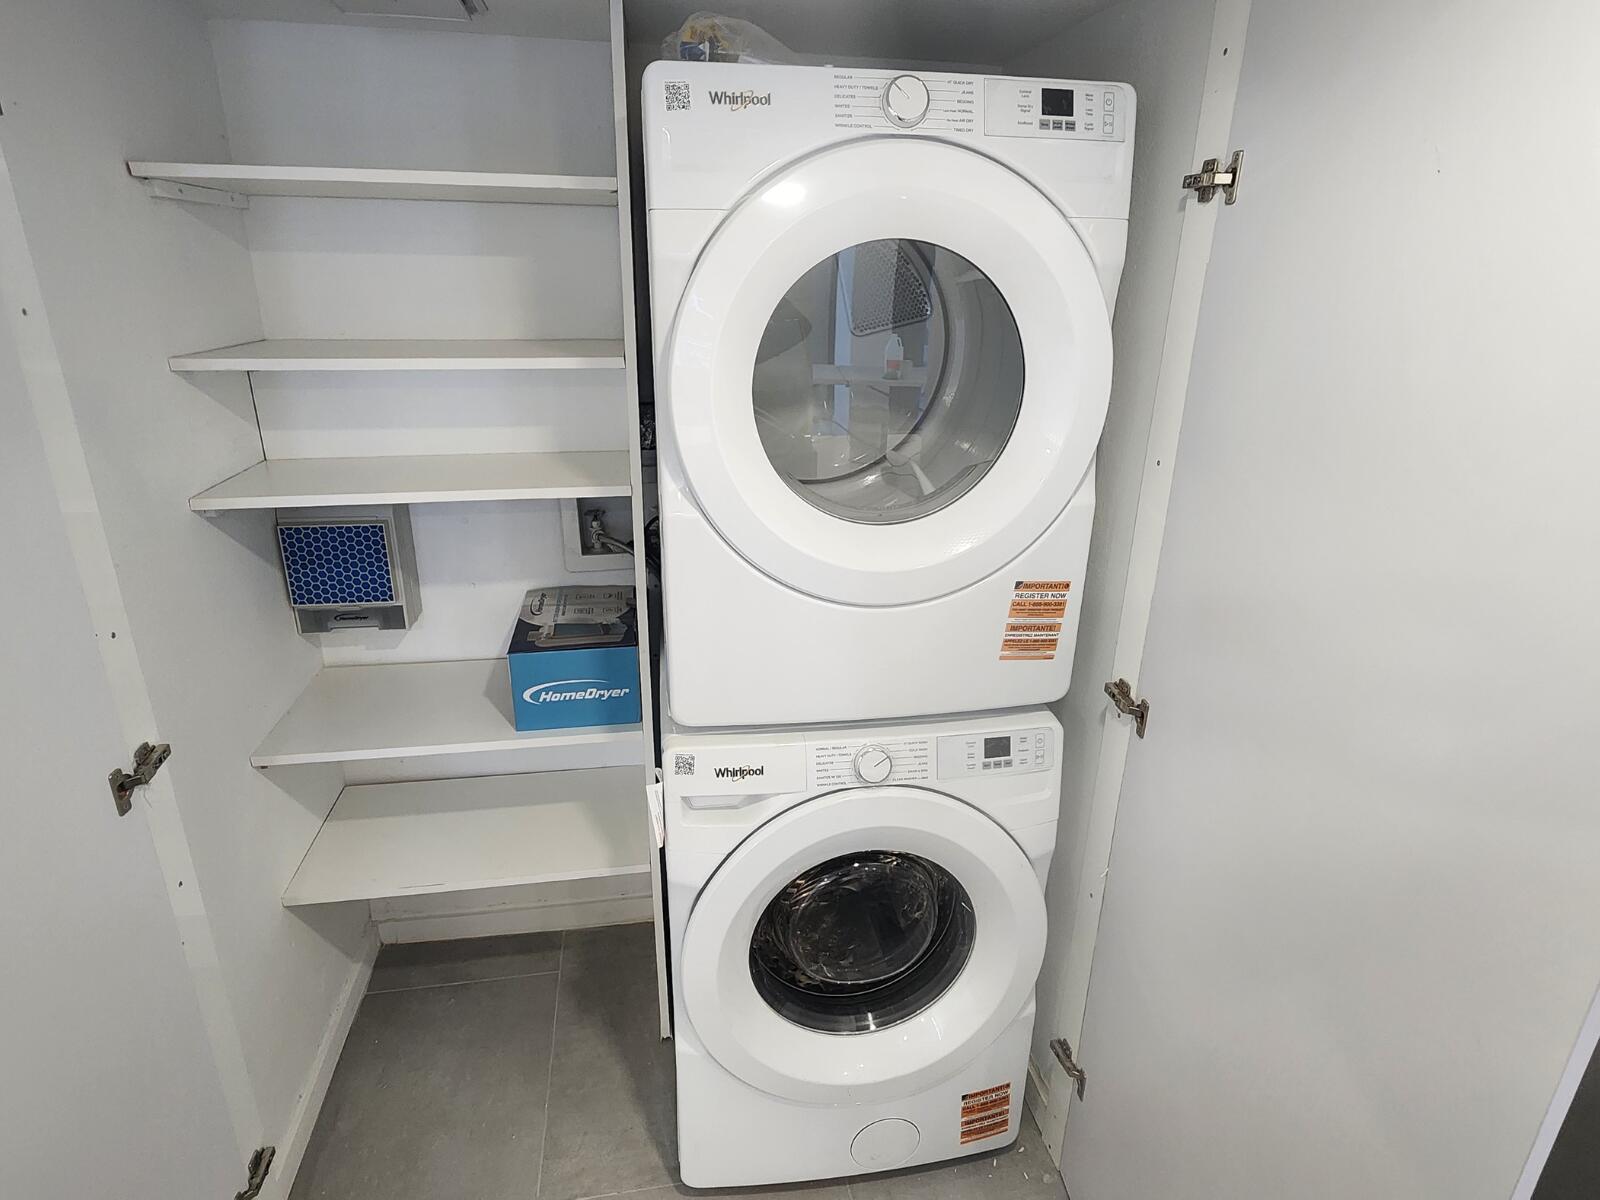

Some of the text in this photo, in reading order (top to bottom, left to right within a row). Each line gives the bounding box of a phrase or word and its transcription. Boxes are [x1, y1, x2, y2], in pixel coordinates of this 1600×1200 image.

[708, 90, 772, 109] Whirlpool
[538, 688, 630, 702] HomeDryer
[714, 765, 764, 781] Whirlpool
